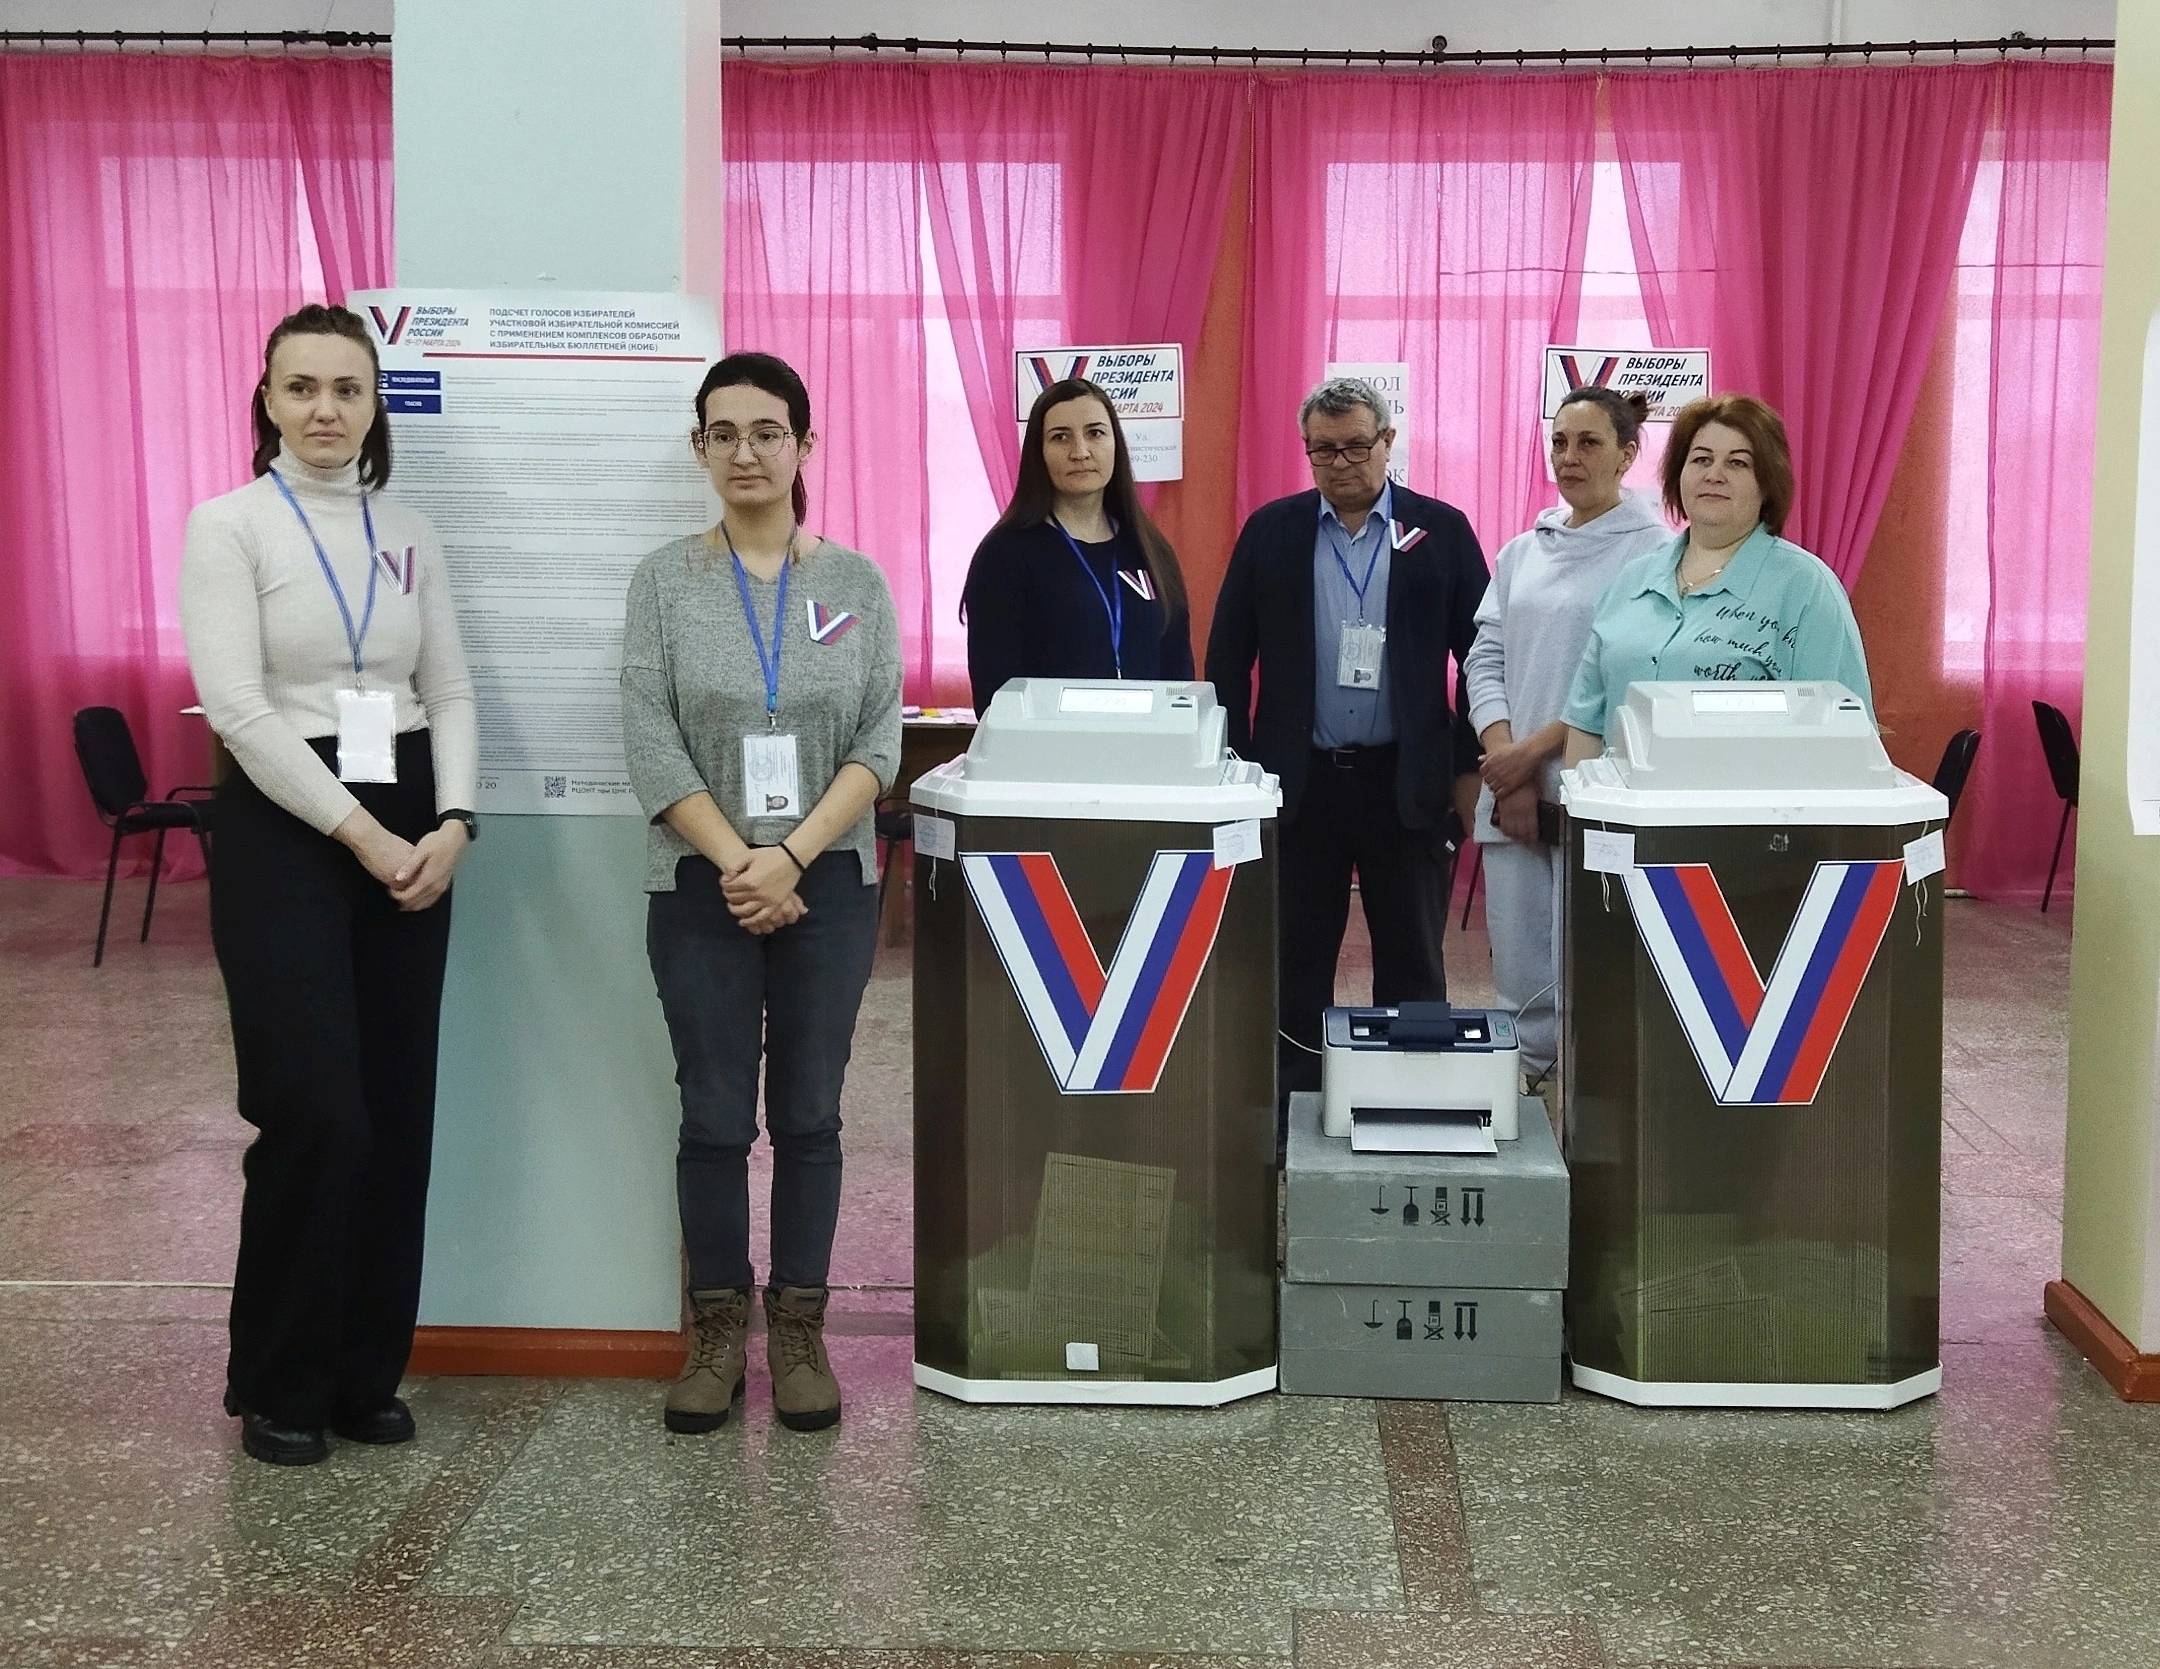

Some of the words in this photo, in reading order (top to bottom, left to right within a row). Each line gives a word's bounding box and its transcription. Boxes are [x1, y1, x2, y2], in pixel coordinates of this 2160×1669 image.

[416, 306, 457, 315] ВЫБОРЫ
[489, 308, 529, 318] ПОДСЧЕТ
[531, 309, 572, 318] ГОЛОСОВ
[573, 309, 636, 319] ИЗБИРАТЕЛЕЙ
[411, 317, 469, 327] ПРЕЗИДЕНТА
[489, 319, 547, 328] УЧАСТКОВОЙ
[548, 320, 623, 329] ИЗБИРАТЕЛЬНОЙ
[624, 321, 680, 330] КОМИССИЕЙ
[407, 328, 444, 337] РОССИИ
[489, 330, 496, 338] С
[497, 330, 565, 339] ПРИМЕНЕНИЕМ
[566, 331, 627, 340] КОМПЛЕКСОВ
[628, 332, 681, 341] ОБРАБОТКИ
[489, 341, 566, 350] ИЗБИРАТЕЛЬНЫХ
[567, 341, 627, 351] БЮЛЛЕТЕНЕЙ
[1097, 354, 1156, 368] ВЫБОРЫ
[1626, 357, 1687, 370] ВЫБОРЫ
[1091, 369, 1174, 384] ПРЕЗИДЕНТА
[1617, 373, 1703, 388] ПРЕЗИДЕНТА
[1727, 638, 1770, 657] much
